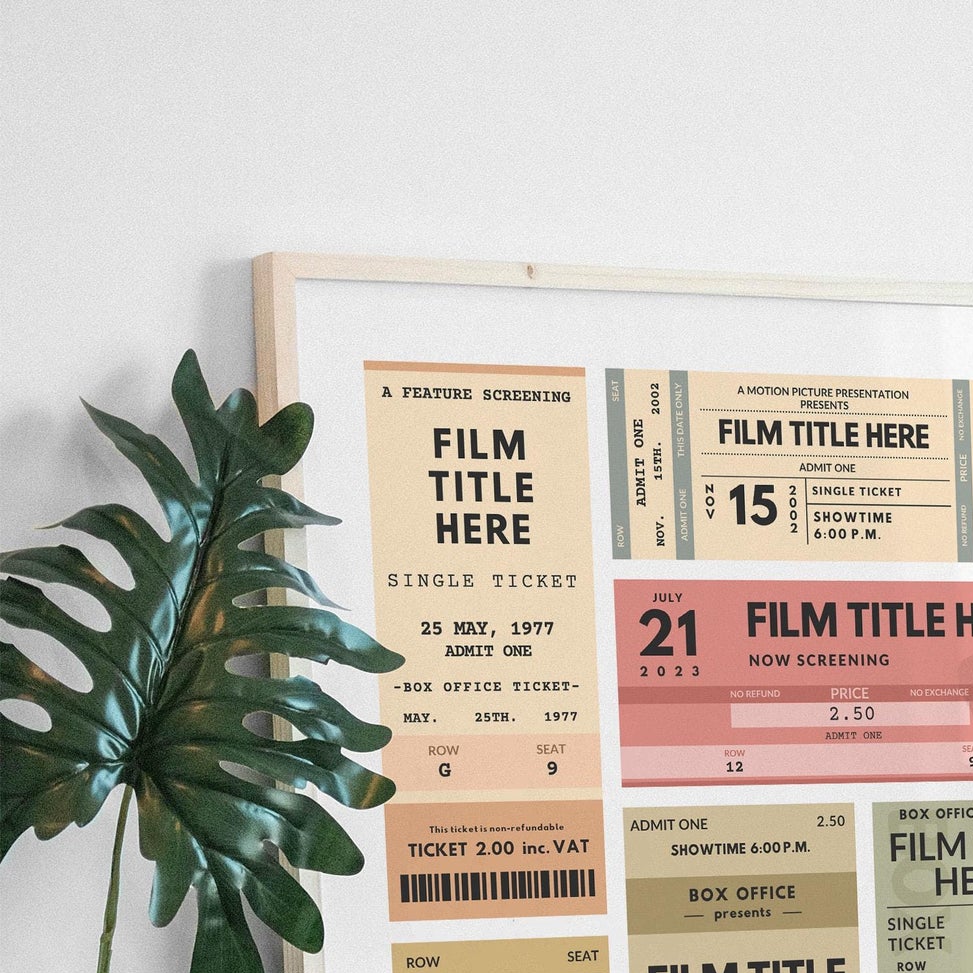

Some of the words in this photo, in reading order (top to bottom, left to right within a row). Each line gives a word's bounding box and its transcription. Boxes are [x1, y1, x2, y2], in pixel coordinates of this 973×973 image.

[381, 386, 393, 398] A
[402, 386, 473, 400] FEATURE
[482, 388, 571, 403] SCREENING
[737, 385, 745, 395] A
[746, 385, 790, 396] MOTION
[791, 386, 833, 398] PICTURE
[835, 388, 910, 400] PRESENTATION
[800, 399, 849, 411] PRESENTS
[718, 418, 783, 446] FILM
[788, 420, 859, 448] TITLE
[865, 422, 930, 449] HERE
[433, 427, 526, 461] FILM
[799, 462, 833, 472] ADMIT
[833, 463, 856, 473] ONE
[428, 470, 534, 503] TITLE
[811, 485, 855, 496] SINGLE
[859, 486, 902, 497] TICKET
[729, 483, 778, 526] 15
[813, 511, 892, 524] SHOWTIME
[435, 512, 531, 545] HERE
[813, 527, 847, 540] 6:00
[850, 528, 881, 541] P.M.
[387, 573, 474, 588] SINGLE
[492, 573, 577, 589] TICKET
[652, 592, 683, 603] JULY
[746, 601, 838, 638] FILM
[846, 601, 946, 638] TITLE
[420, 621, 443, 636] 25
[453, 621, 496, 638] MAY,
[511, 621, 554, 636] 1977
[639, 608, 697, 657] 21
[444, 644, 494, 657] ADMIT
[502, 644, 533, 657] ONE
[749, 653, 791, 667] NOW
[796, 653, 890, 667] SCREENING
[443, 681, 502, 693] OFFICE
[729, 689, 745, 699] NO
[745, 689, 781, 698] REFUND
[830, 687, 869, 700] PRICE
[909, 688, 924, 697] NO
[924, 688, 969, 697] EXCHANGE
[403, 712, 437, 724] MAY.
[474, 712, 516, 723] 25TH.
[544, 711, 578, 722] 1977
[829, 705, 875, 721] 2.50
[724, 749, 746, 758] ROW
[726, 760, 744, 773] 12
[816, 814, 846, 828] 2.50
[899, 808, 930, 821] BOX
[429, 825, 449, 834] This
[450, 825, 478, 834] ticket
[489, 823, 565, 833] non-refundable
[630, 818, 676, 832] ADMIT
[678, 817, 708, 831] ONE
[407, 841, 468, 858] TICKET
[476, 840, 515, 856] 2.00
[522, 841, 550, 855] inc.
[552, 838, 590, 854] VAT
[671, 842, 746, 857] SHOWTIME
[750, 841, 781, 855] 6:00
[783, 840, 810, 853] P.M.
[890, 831, 966, 862] FILM
[689, 887, 728, 903] BOX
[736, 885, 796, 901] OFFICE
[714, 907, 772, 922] presents
[887, 915, 945, 932] SINGLE
[887, 935, 946, 952] TICKET
[406, 956, 441, 969] ROW
[567, 949, 600, 963] SEAT
[896, 960, 927, 972] ROW
